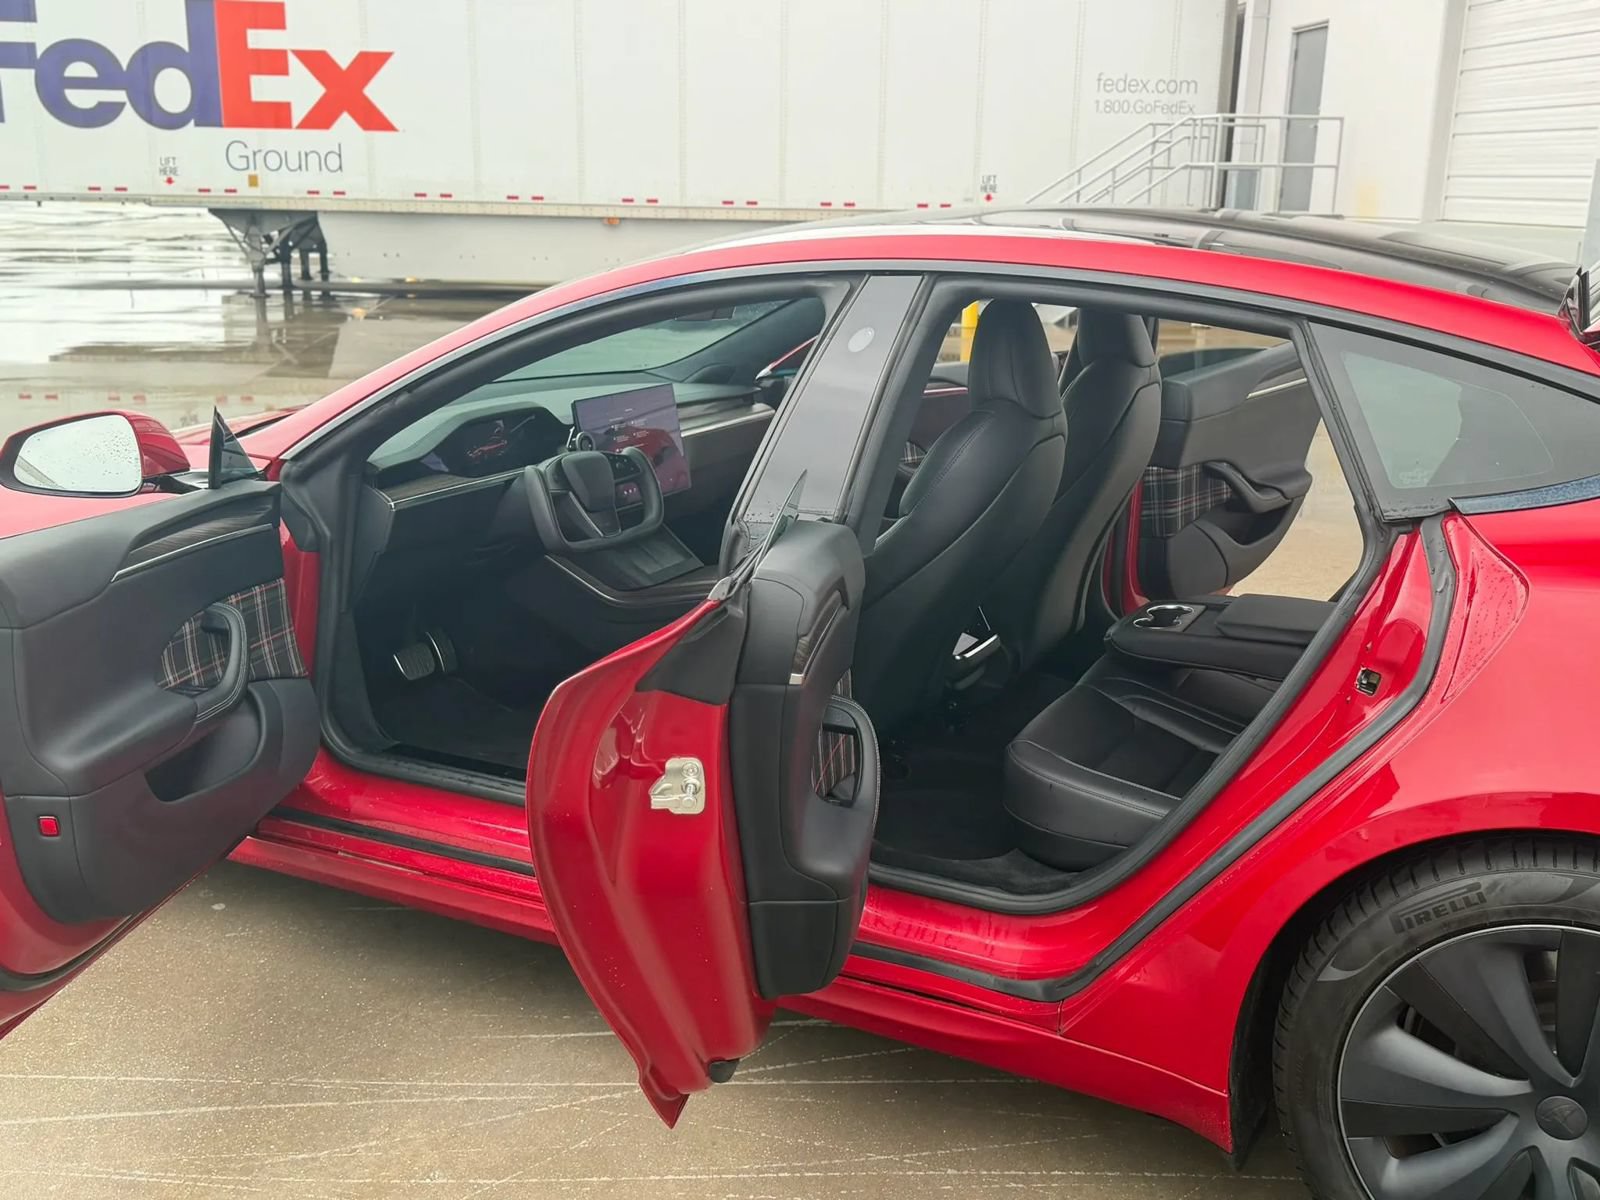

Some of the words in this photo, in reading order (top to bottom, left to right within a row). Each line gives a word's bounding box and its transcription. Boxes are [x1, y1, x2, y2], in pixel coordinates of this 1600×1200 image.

[1096, 72, 1198, 94] fedex.com
[1094, 99, 1195, 115] 1.800.GoFedEx
[159, 156, 177, 167] LIFT
[225, 139, 343, 173] Ground
[158, 166, 181, 177] HERE
[981, 174, 998, 185] LIFT
[980, 184, 998, 193] HERE
[1389, 881, 1487, 934] PIRELLI
